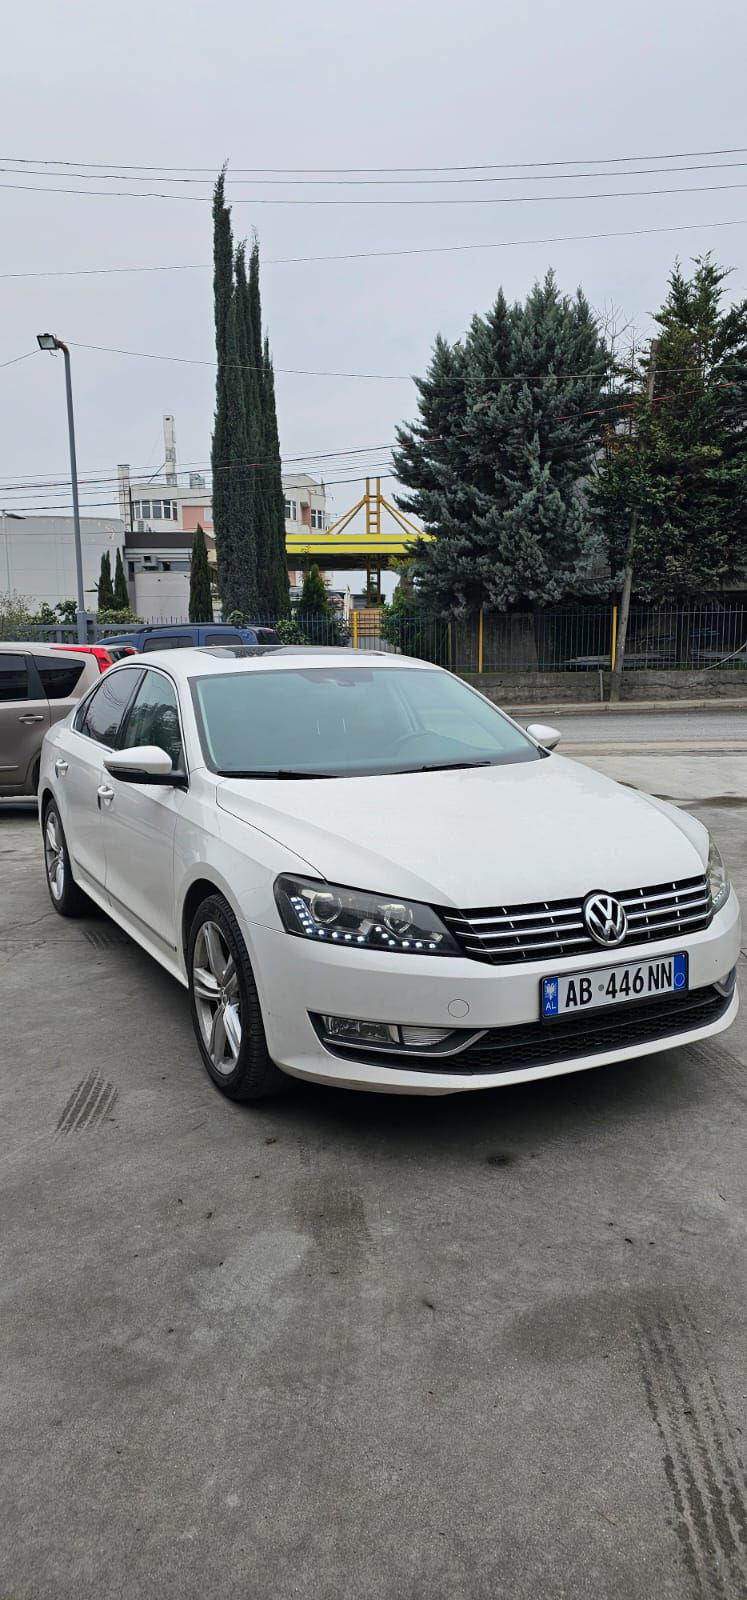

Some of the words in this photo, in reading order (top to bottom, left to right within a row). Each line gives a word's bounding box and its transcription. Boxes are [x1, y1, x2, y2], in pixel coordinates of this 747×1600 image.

[565, 978, 593, 1008] AB
[605, 967, 644, 999] 446
[647, 961, 672, 992] NN
[545, 1002, 557, 1011] AL
